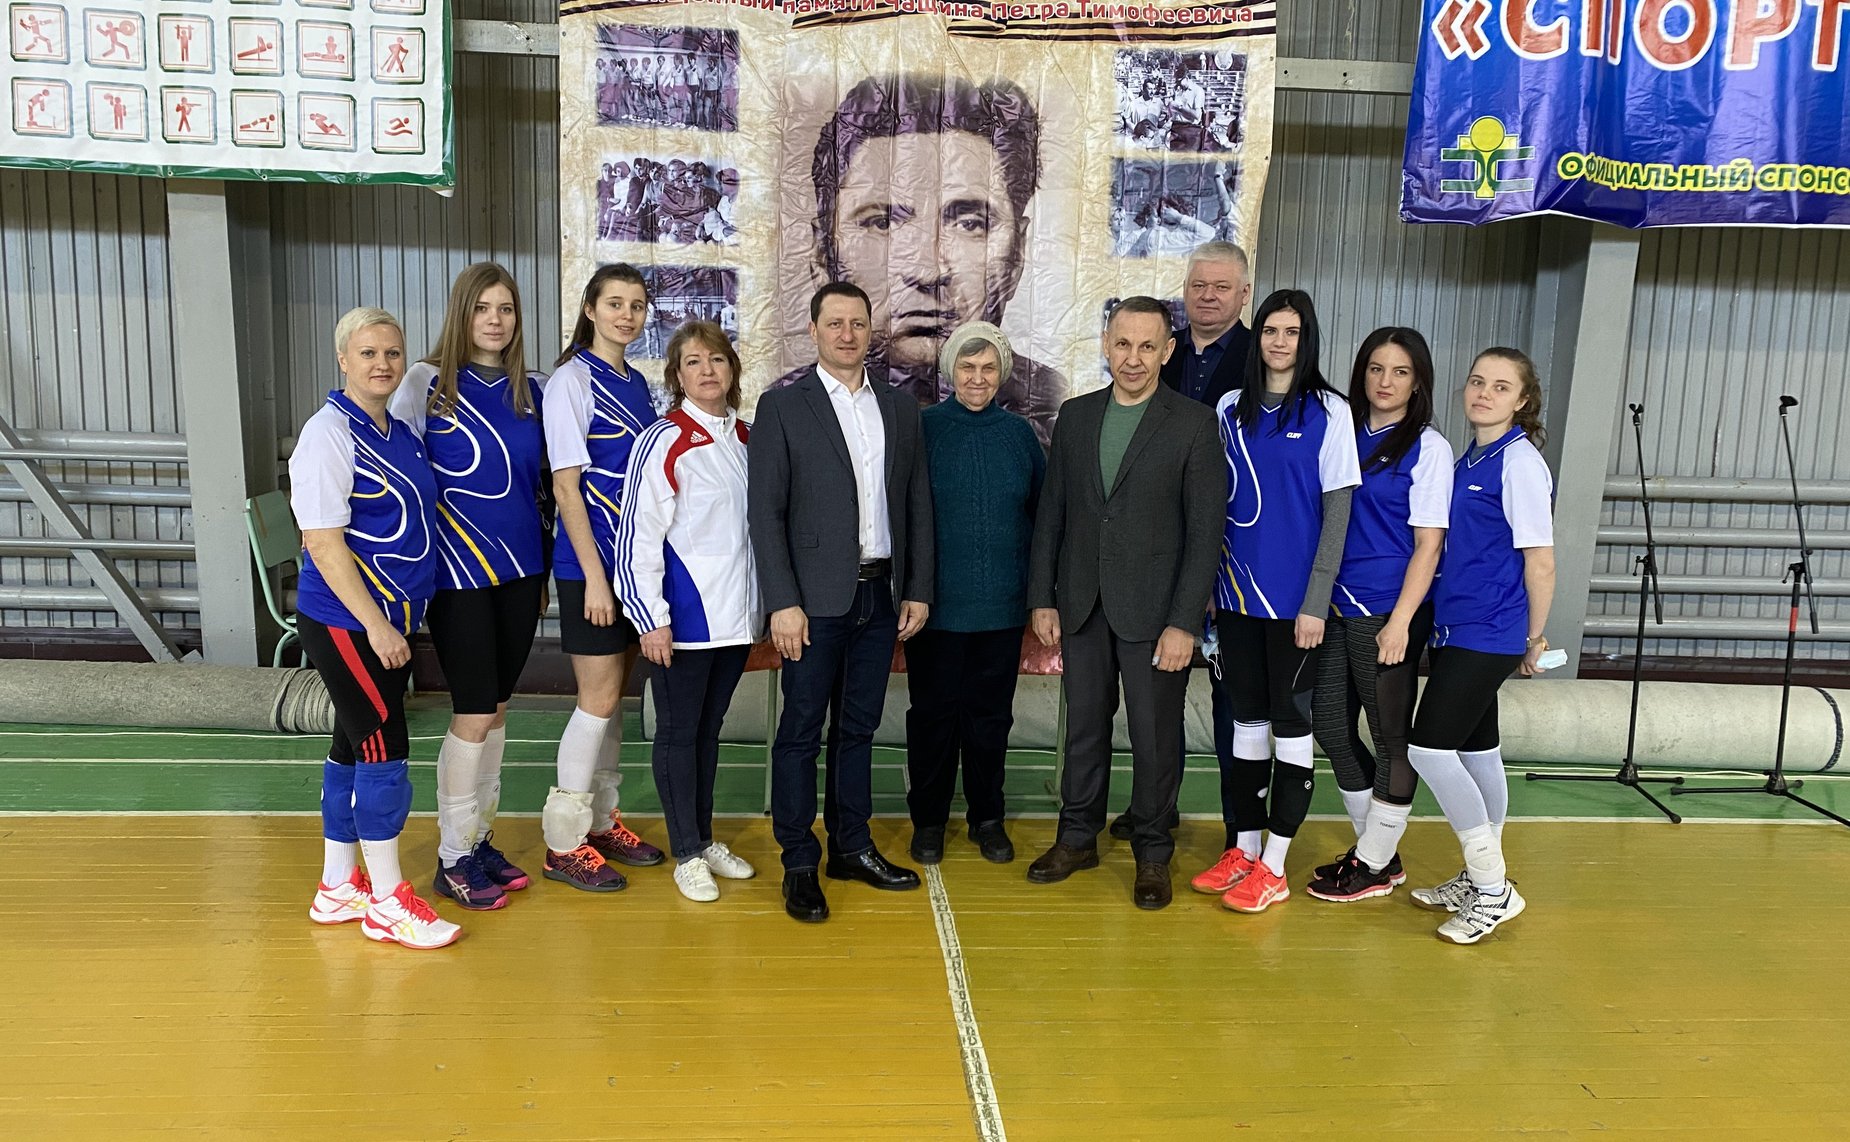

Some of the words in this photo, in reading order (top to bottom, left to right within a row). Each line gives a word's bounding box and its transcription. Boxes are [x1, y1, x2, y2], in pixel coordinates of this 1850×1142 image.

[783, 0, 876, 14] памяти
[885, 0, 983, 18] Чащина
[991, 0, 1070, 22] Петра
[1078, 0, 1254, 25] Тимофеевича
[1559, 153, 1752, 190] ОФИЦИАЛЬНЫЙ
[1758, 165, 1850, 192] СПОНС
